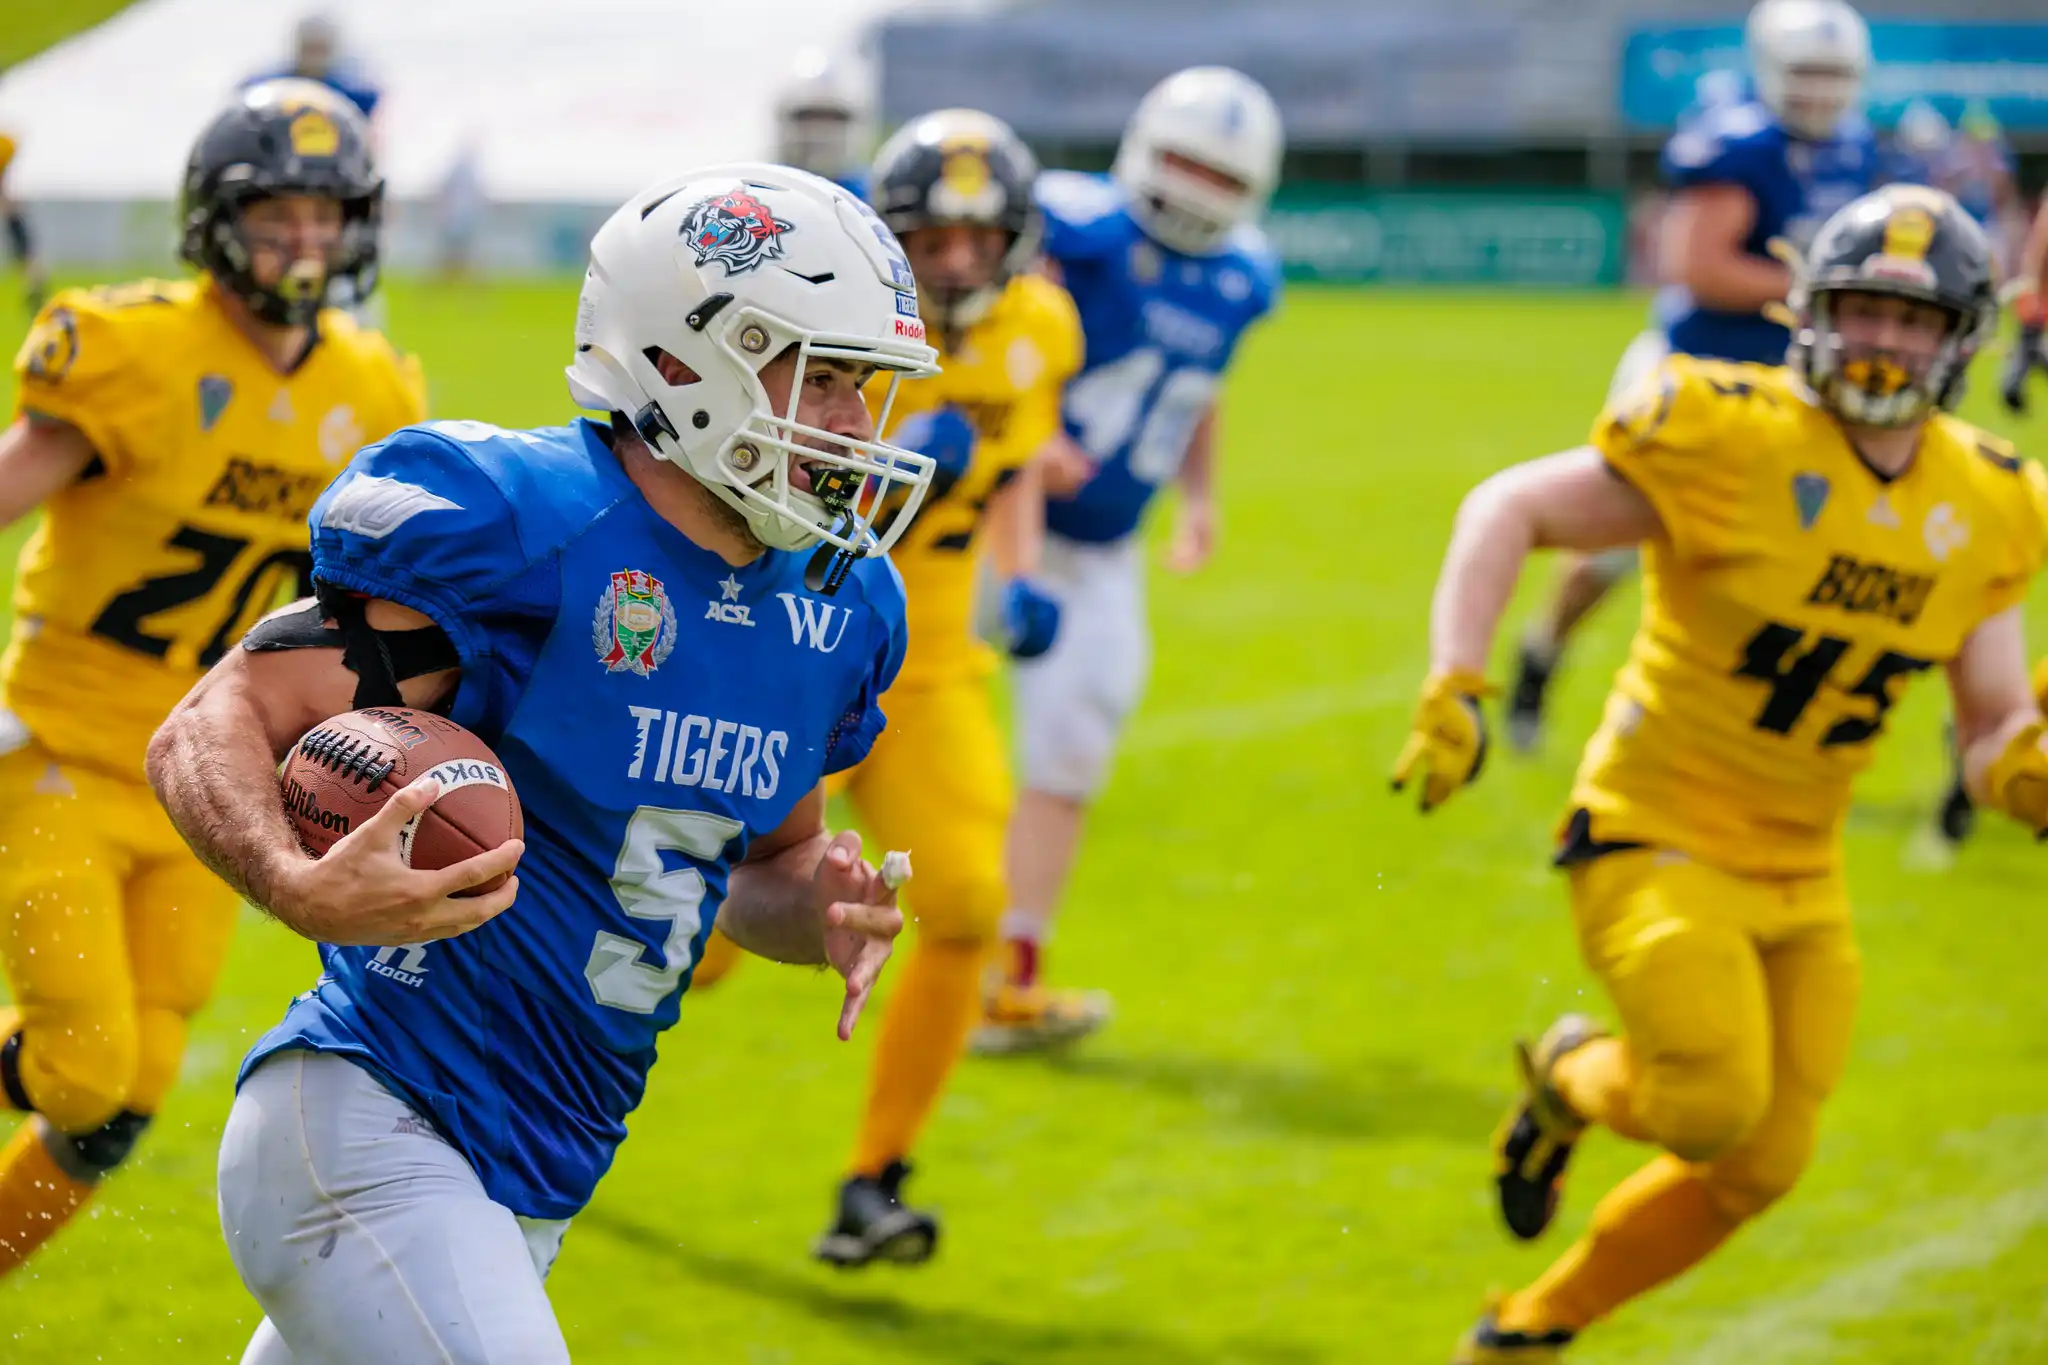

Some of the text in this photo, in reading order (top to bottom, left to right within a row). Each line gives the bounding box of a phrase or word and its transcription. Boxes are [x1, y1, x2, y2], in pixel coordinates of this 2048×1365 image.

[705, 601, 755, 627] ACSL
[776, 593, 853, 653] WU
[1732, 623, 1936, 746] 45
[628, 705, 789, 799] TIGERS
[283, 777, 349, 835] Wilson
[584, 805, 745, 1014] 5
